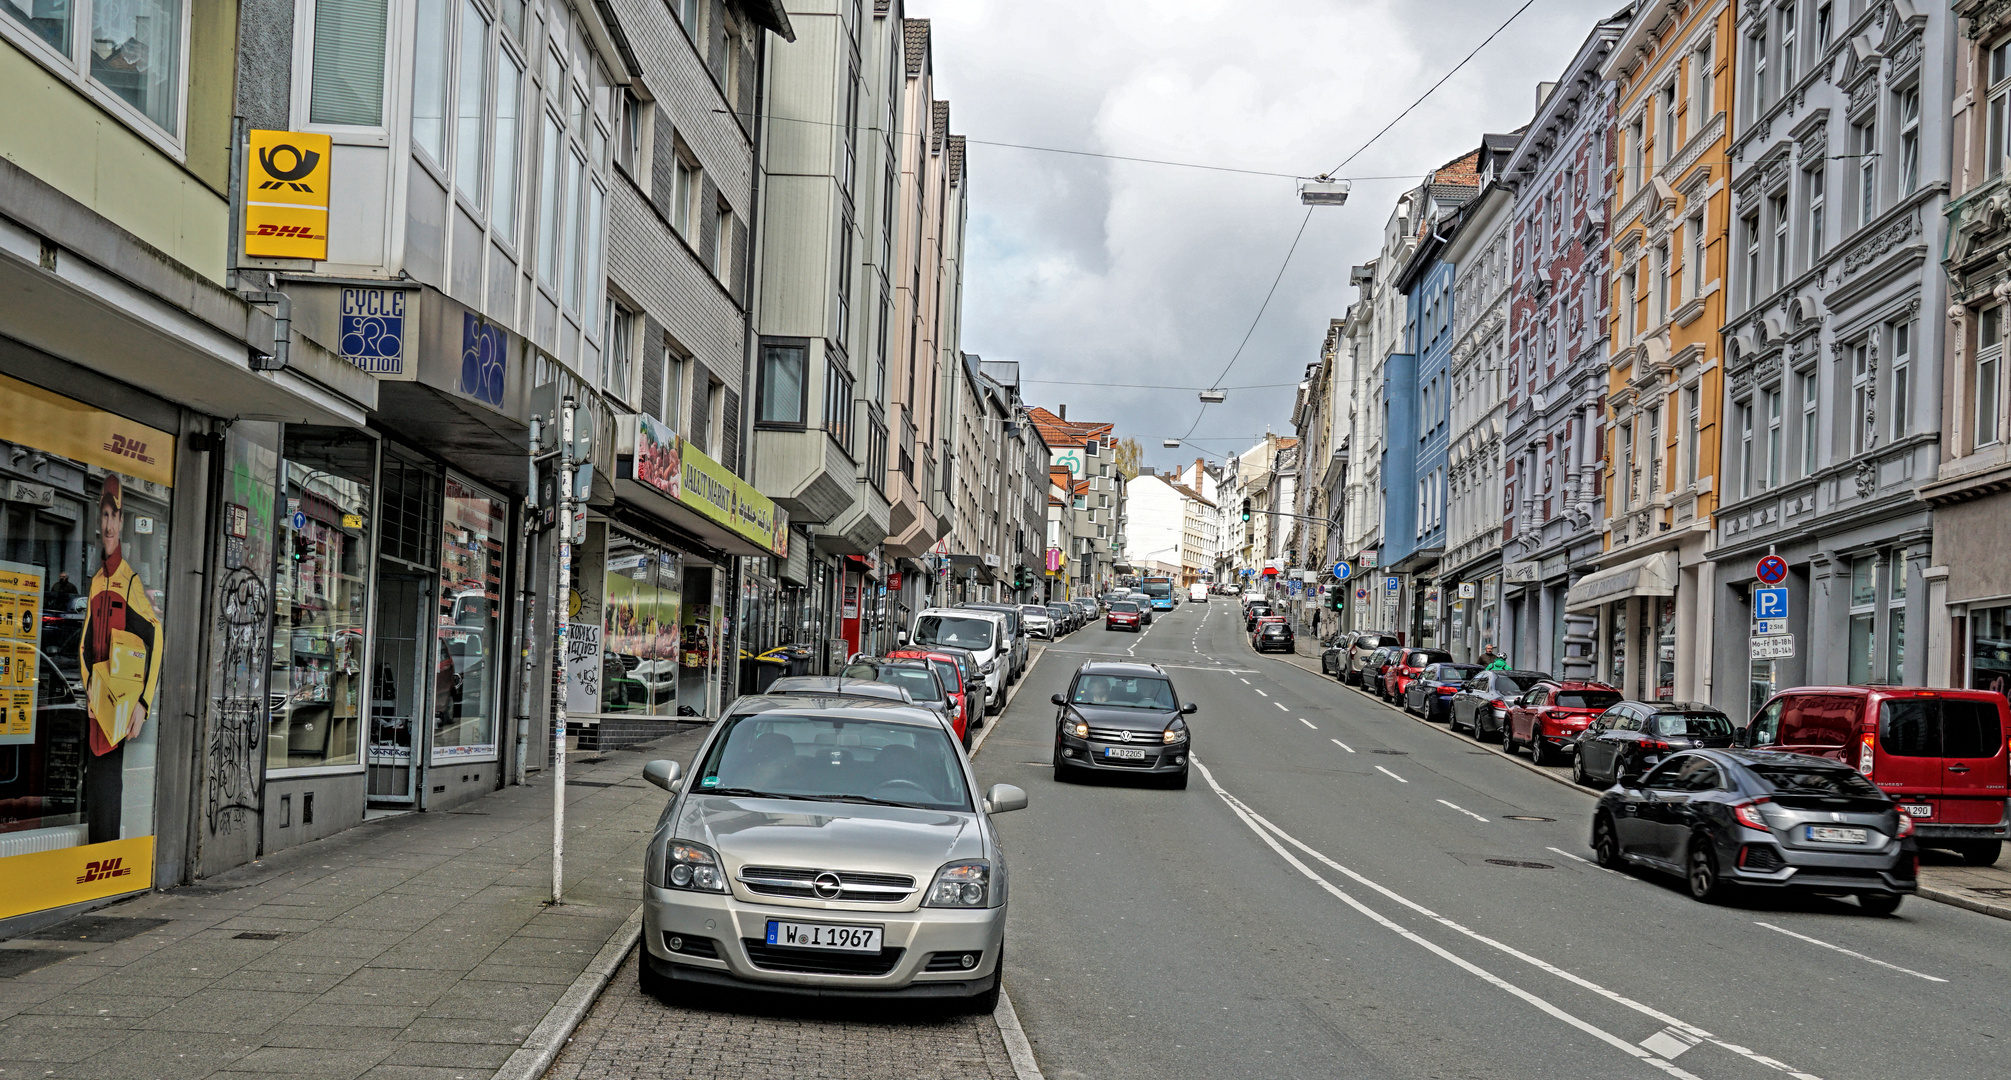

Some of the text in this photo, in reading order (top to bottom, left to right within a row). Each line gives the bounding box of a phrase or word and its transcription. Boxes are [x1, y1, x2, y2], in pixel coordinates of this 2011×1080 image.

[257, 224, 315, 239] DHL
[342, 289, 404, 317] CYCLE
[342, 356, 401, 372] TATION
[110, 433, 150, 463] DHL
[684, 462, 730, 513] JALUT MARKT
[1389, 579, 1396, 589] P
[1761, 592, 1778, 615] P
[1752, 639, 1770, 648] Mo-Fr
[1125, 750, 1142, 758] 2205
[1912, 806, 1928, 815] 290
[84, 857, 124, 883] DHL
[786, 925, 798, 944] W
[811, 927, 821, 945] I
[826, 928, 874, 948] 1967
